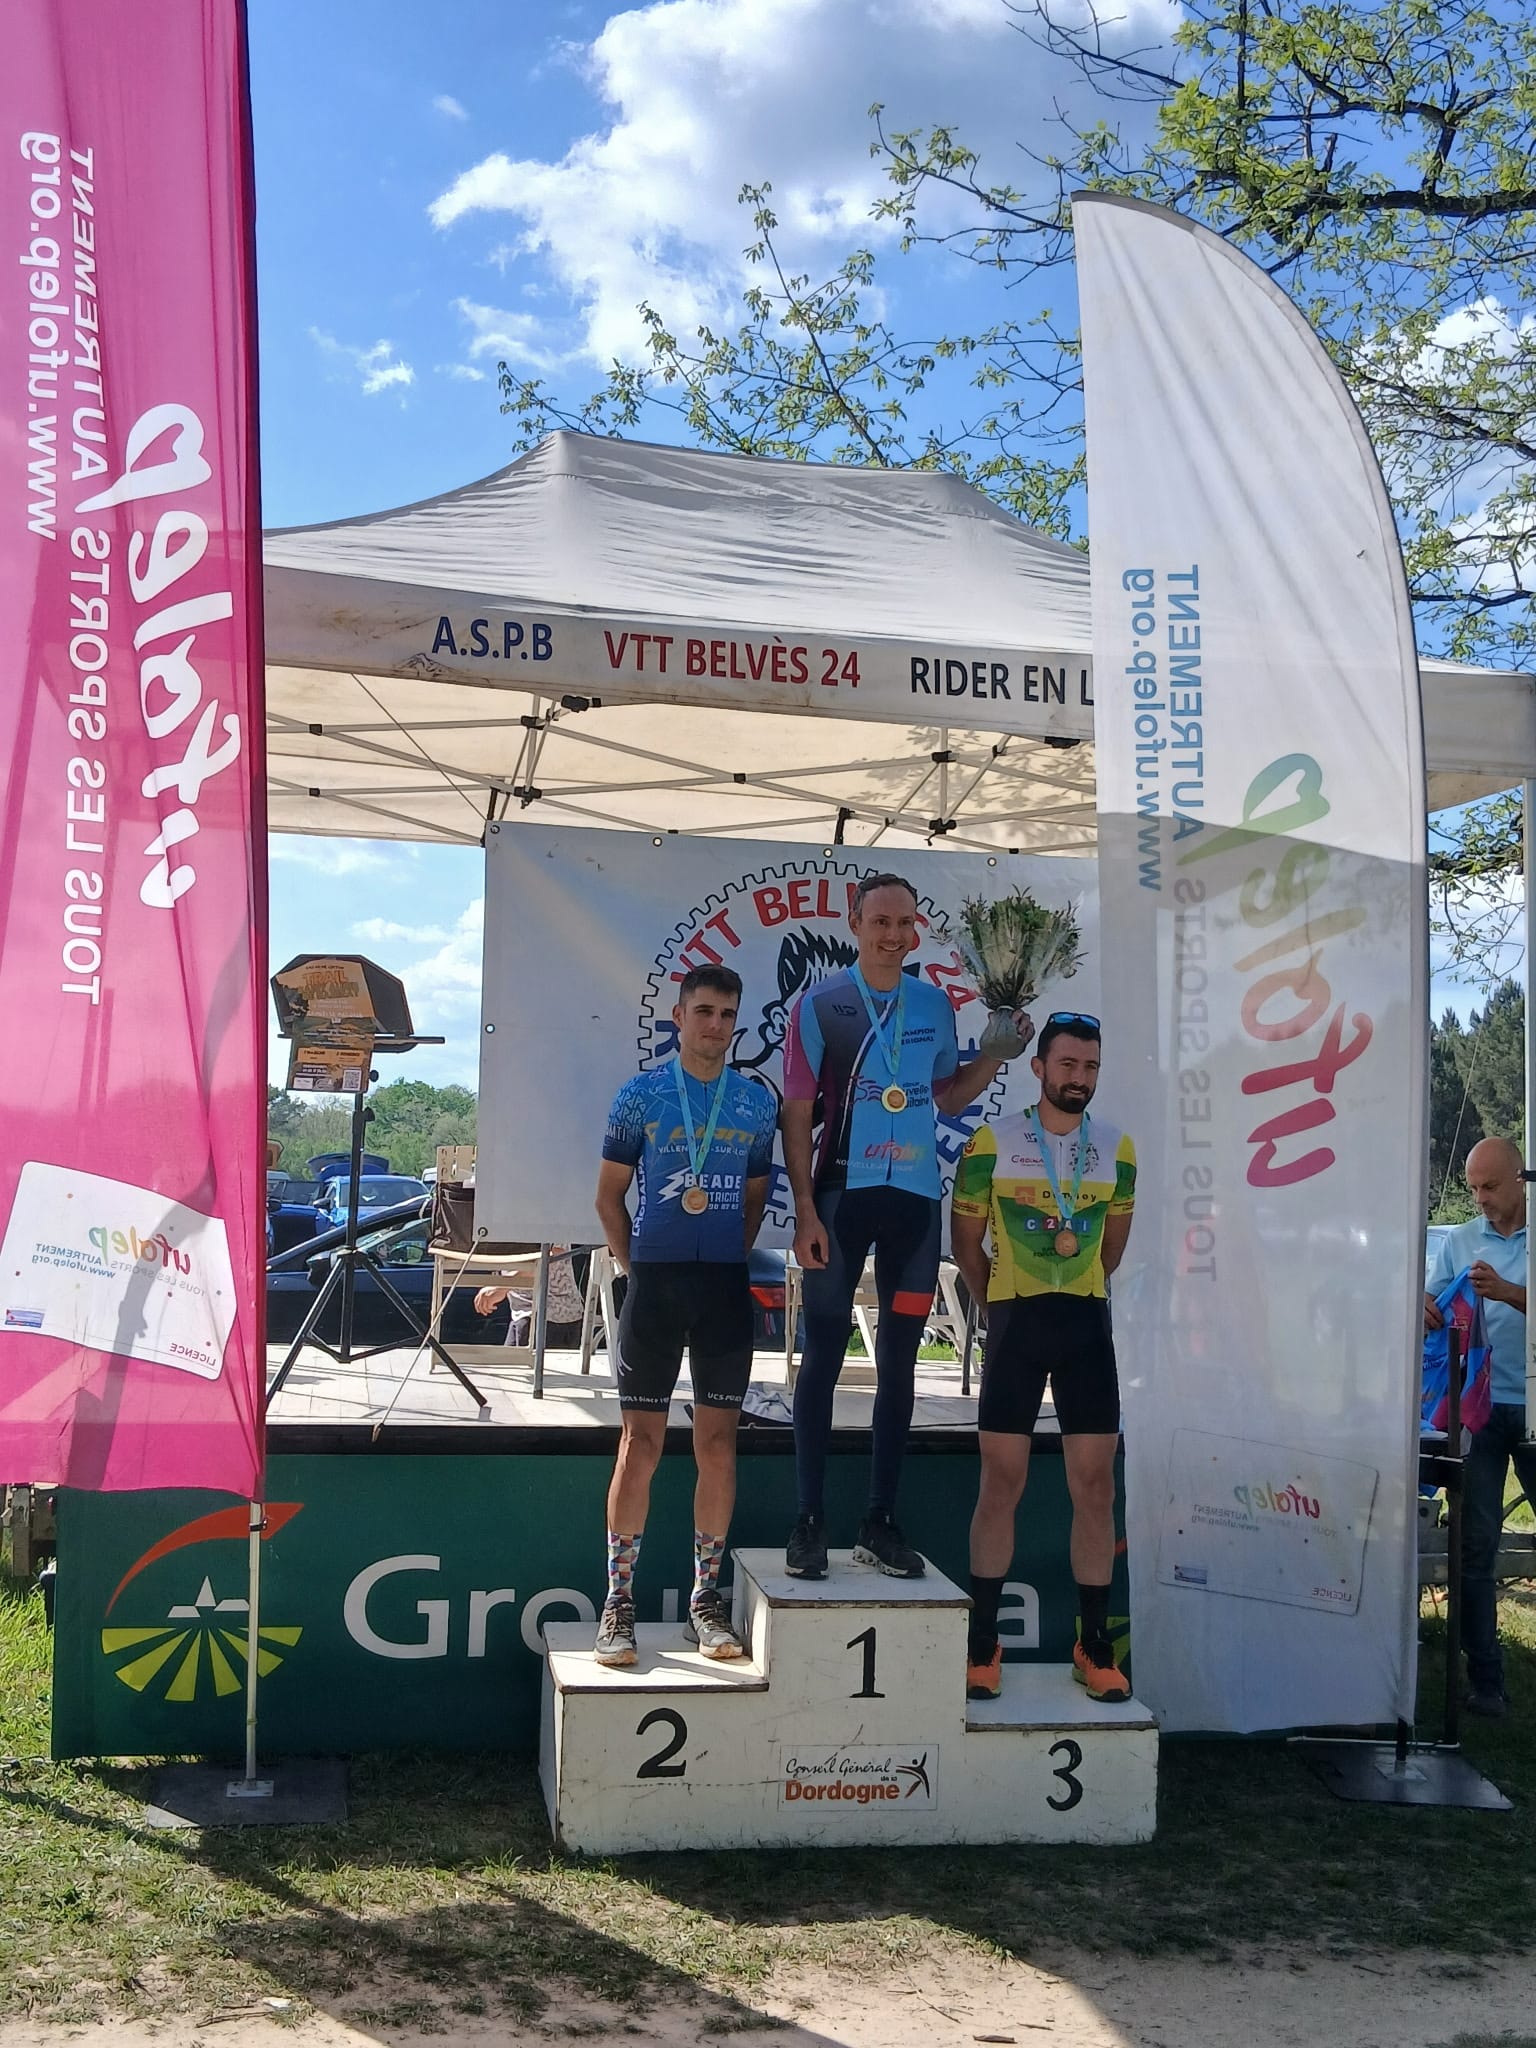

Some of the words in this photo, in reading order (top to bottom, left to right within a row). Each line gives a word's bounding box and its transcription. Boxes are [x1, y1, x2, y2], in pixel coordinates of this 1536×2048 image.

[432, 615, 553, 662] A.S.P.B
[604, 630, 674, 673] VTT
[686, 636, 809, 685] BELVÈS
[820, 648, 861, 689] 24
[910, 656, 1011, 701] RIDER
[1023, 665, 1066, 705] EN
[846, 1626, 886, 1699] 1
[636, 1707, 688, 1779] 2
[784, 1778, 900, 1805] Dordogne
[1047, 1738, 1084, 1812] 3
